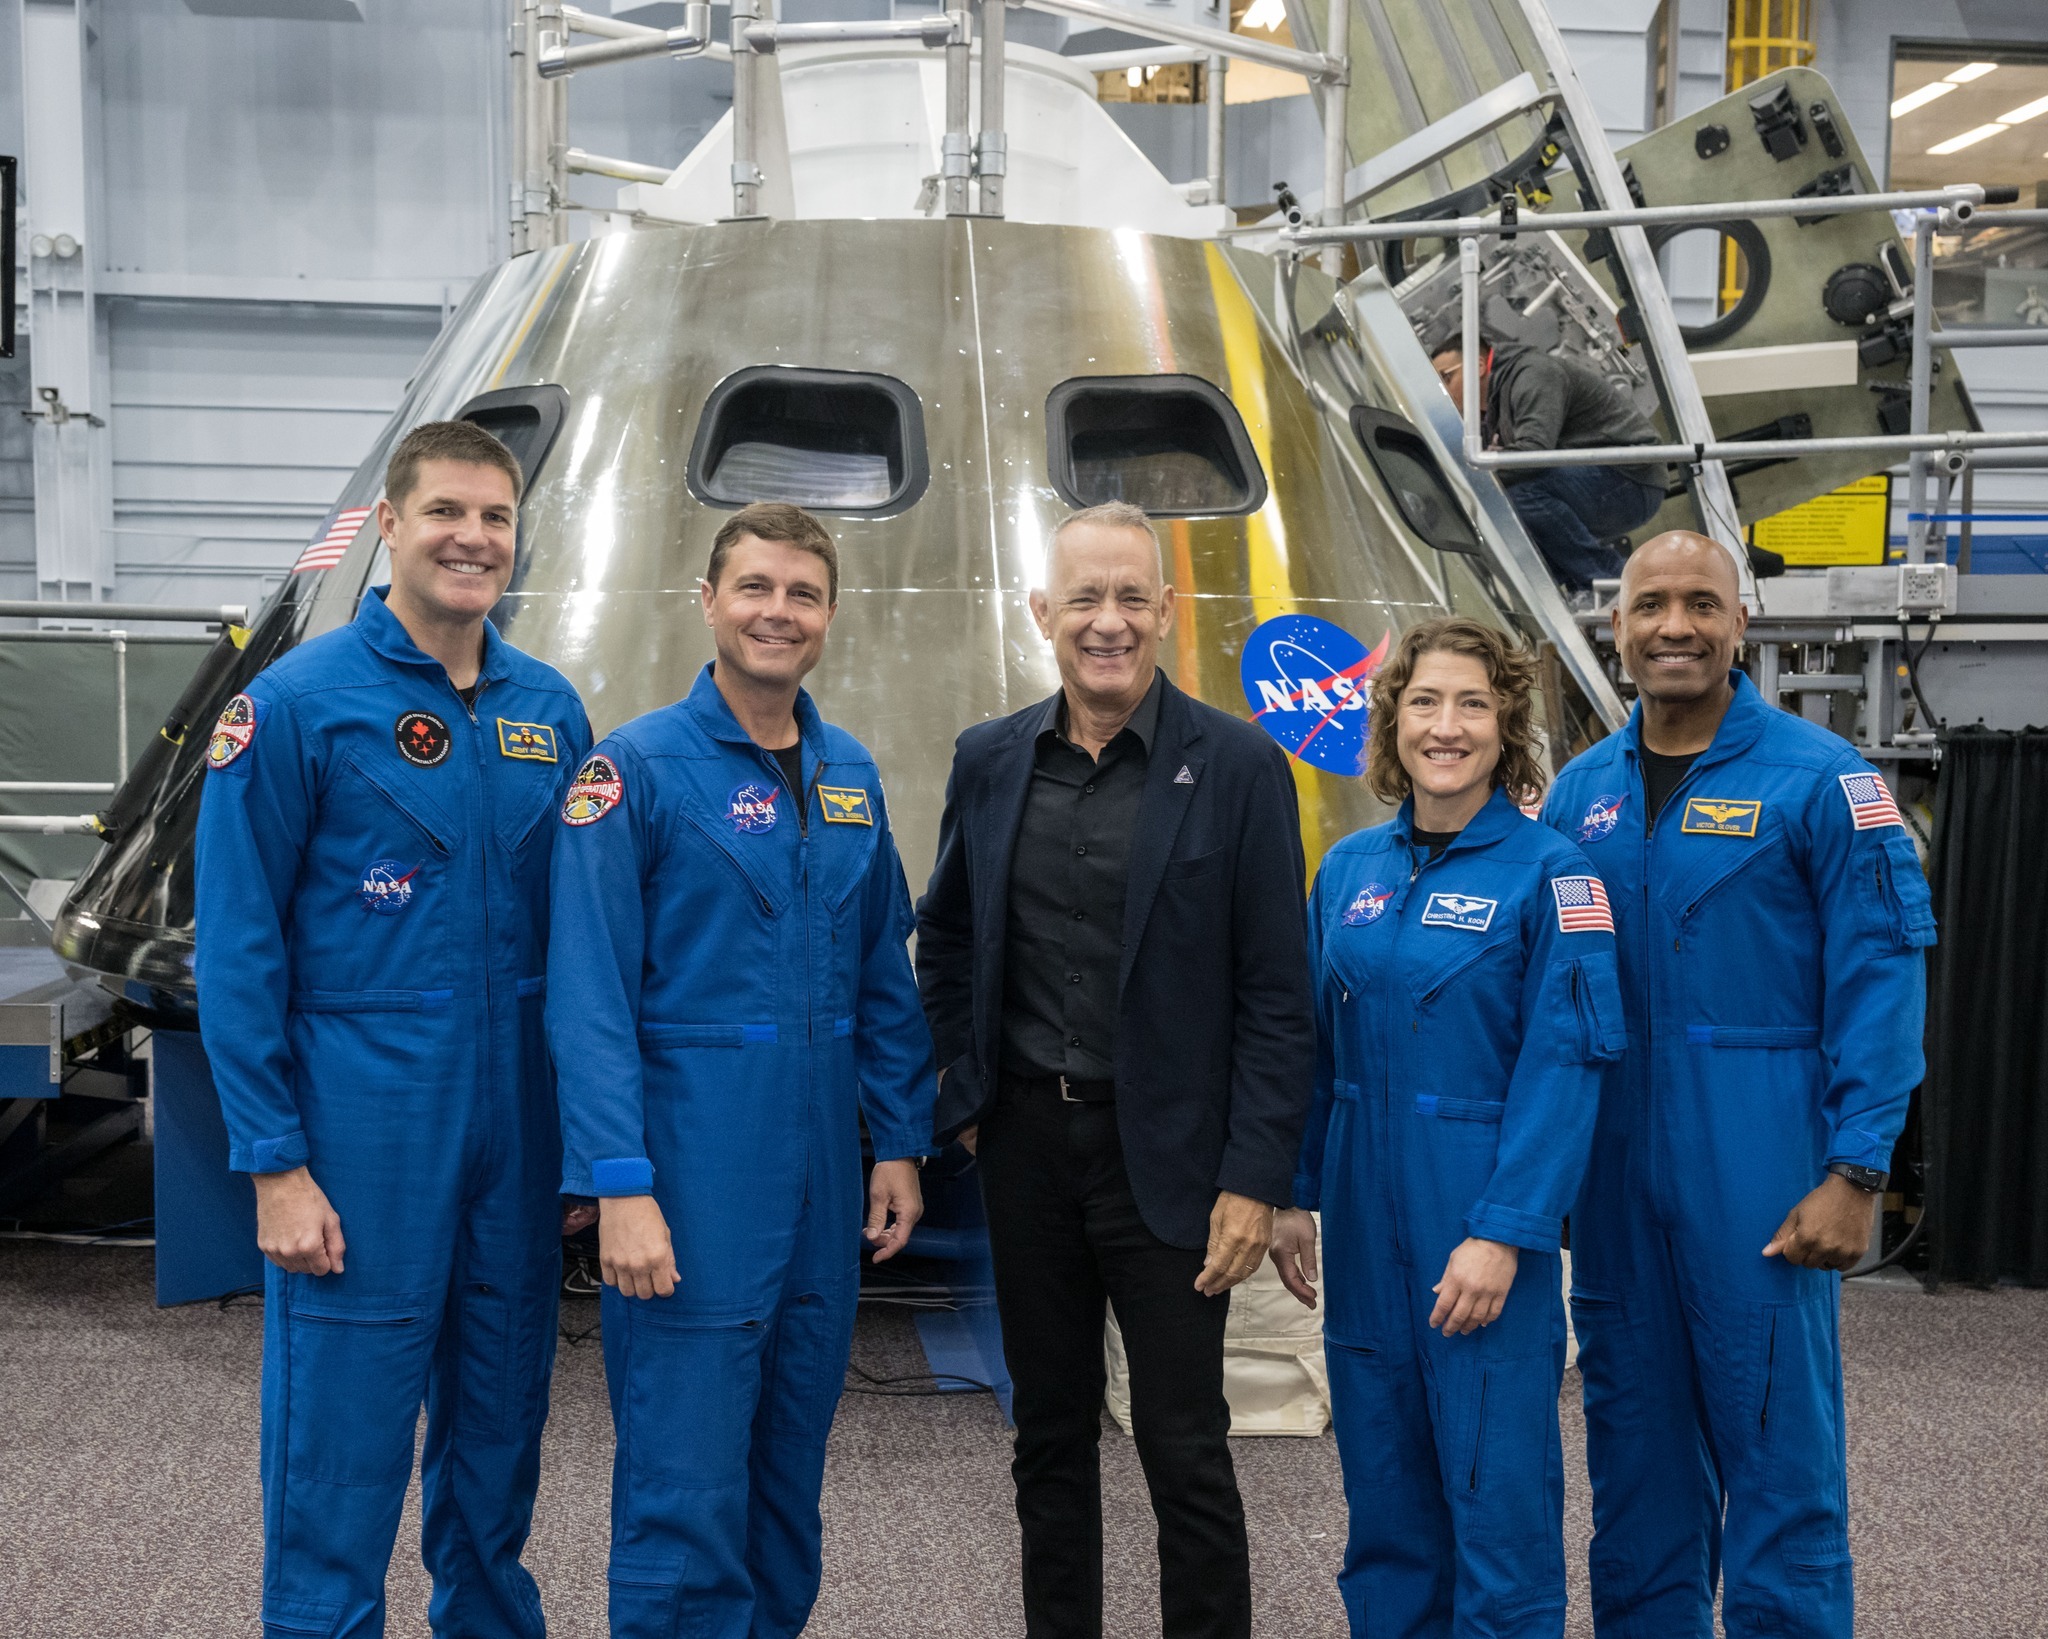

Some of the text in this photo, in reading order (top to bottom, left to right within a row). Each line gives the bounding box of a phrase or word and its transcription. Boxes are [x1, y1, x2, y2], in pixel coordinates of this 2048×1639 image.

[1254, 677, 1373, 713] NAS
[397, 713, 413, 732] CANADIAN
[427, 715, 445, 730] AGENCY
[732, 803, 776, 815] NASA
[1583, 810, 1618, 826] NASA
[1718, 823, 1741, 831] GLOVER
[362, 880, 412, 894] NASA
[1349, 898, 1385, 911] NASA
[1427, 912, 1456, 922] CHRISTINA
[1468, 916, 1485, 925] KOCH
